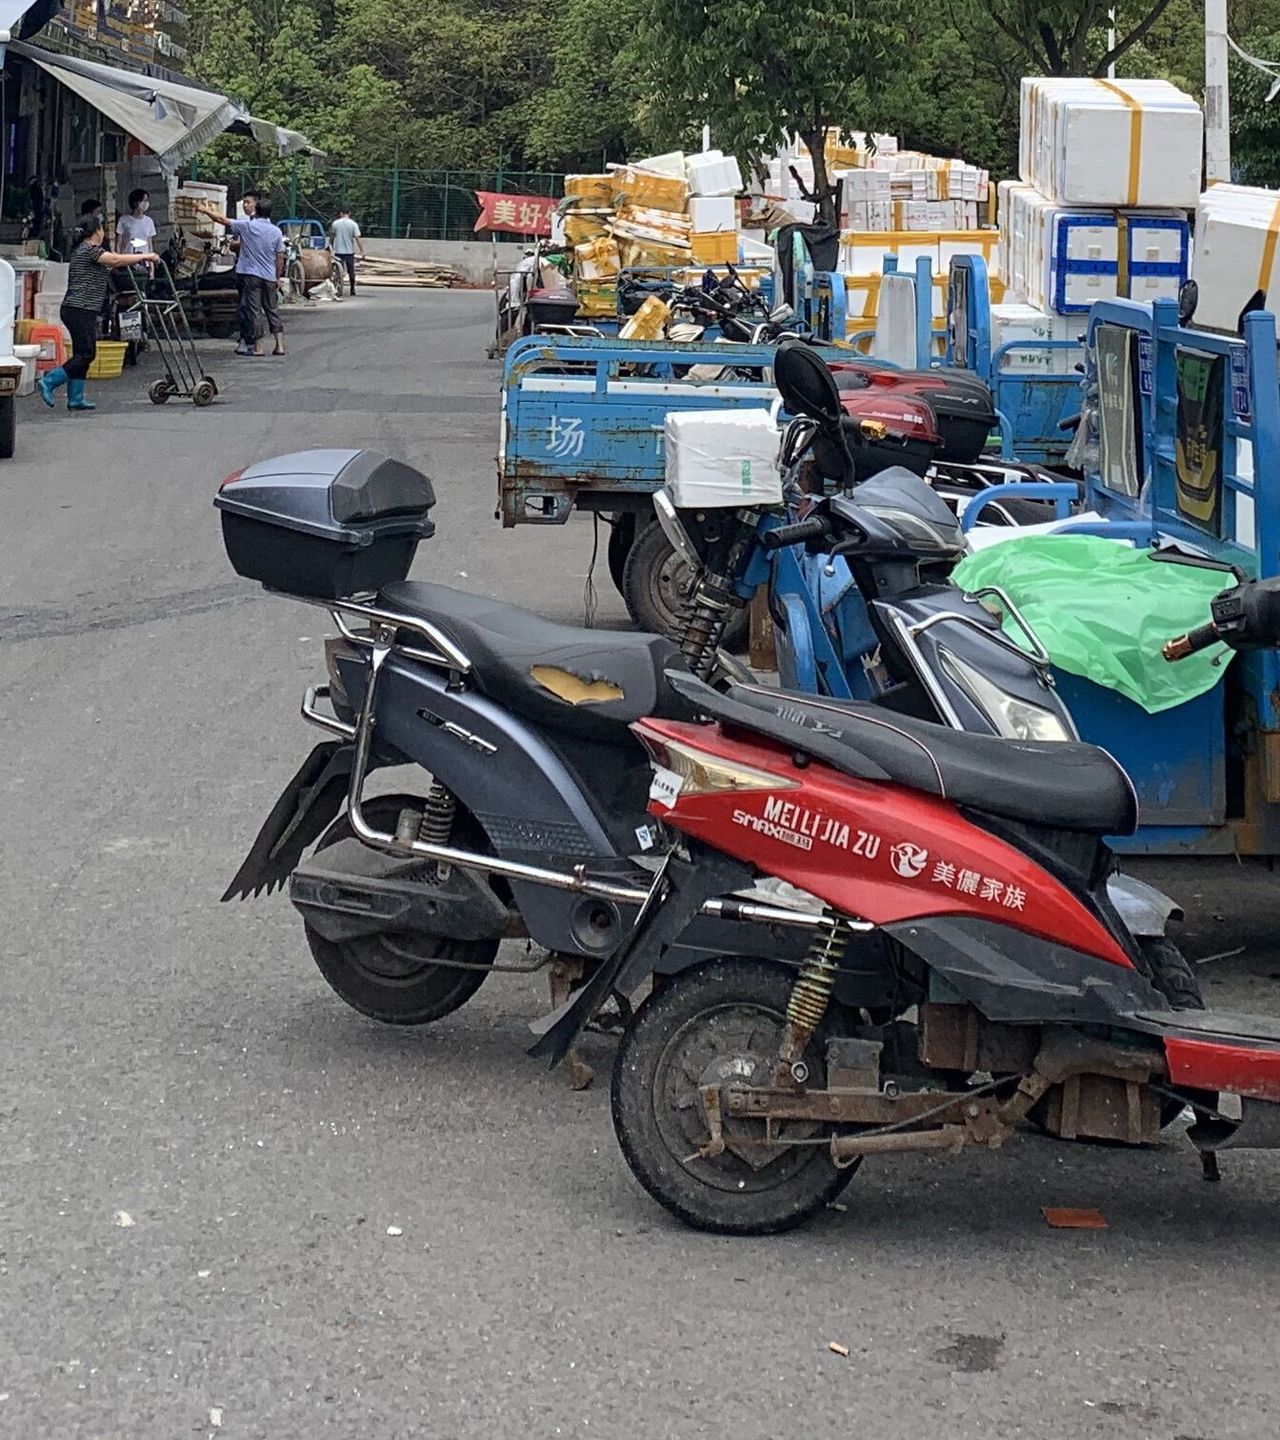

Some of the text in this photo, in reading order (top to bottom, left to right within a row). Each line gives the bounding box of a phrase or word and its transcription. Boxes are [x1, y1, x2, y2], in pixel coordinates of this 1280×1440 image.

[545, 415, 586, 458] 场
[731, 809, 781, 838] SMAX
[820, 820, 850, 849] JIA
[852, 830, 880, 859] ZU
